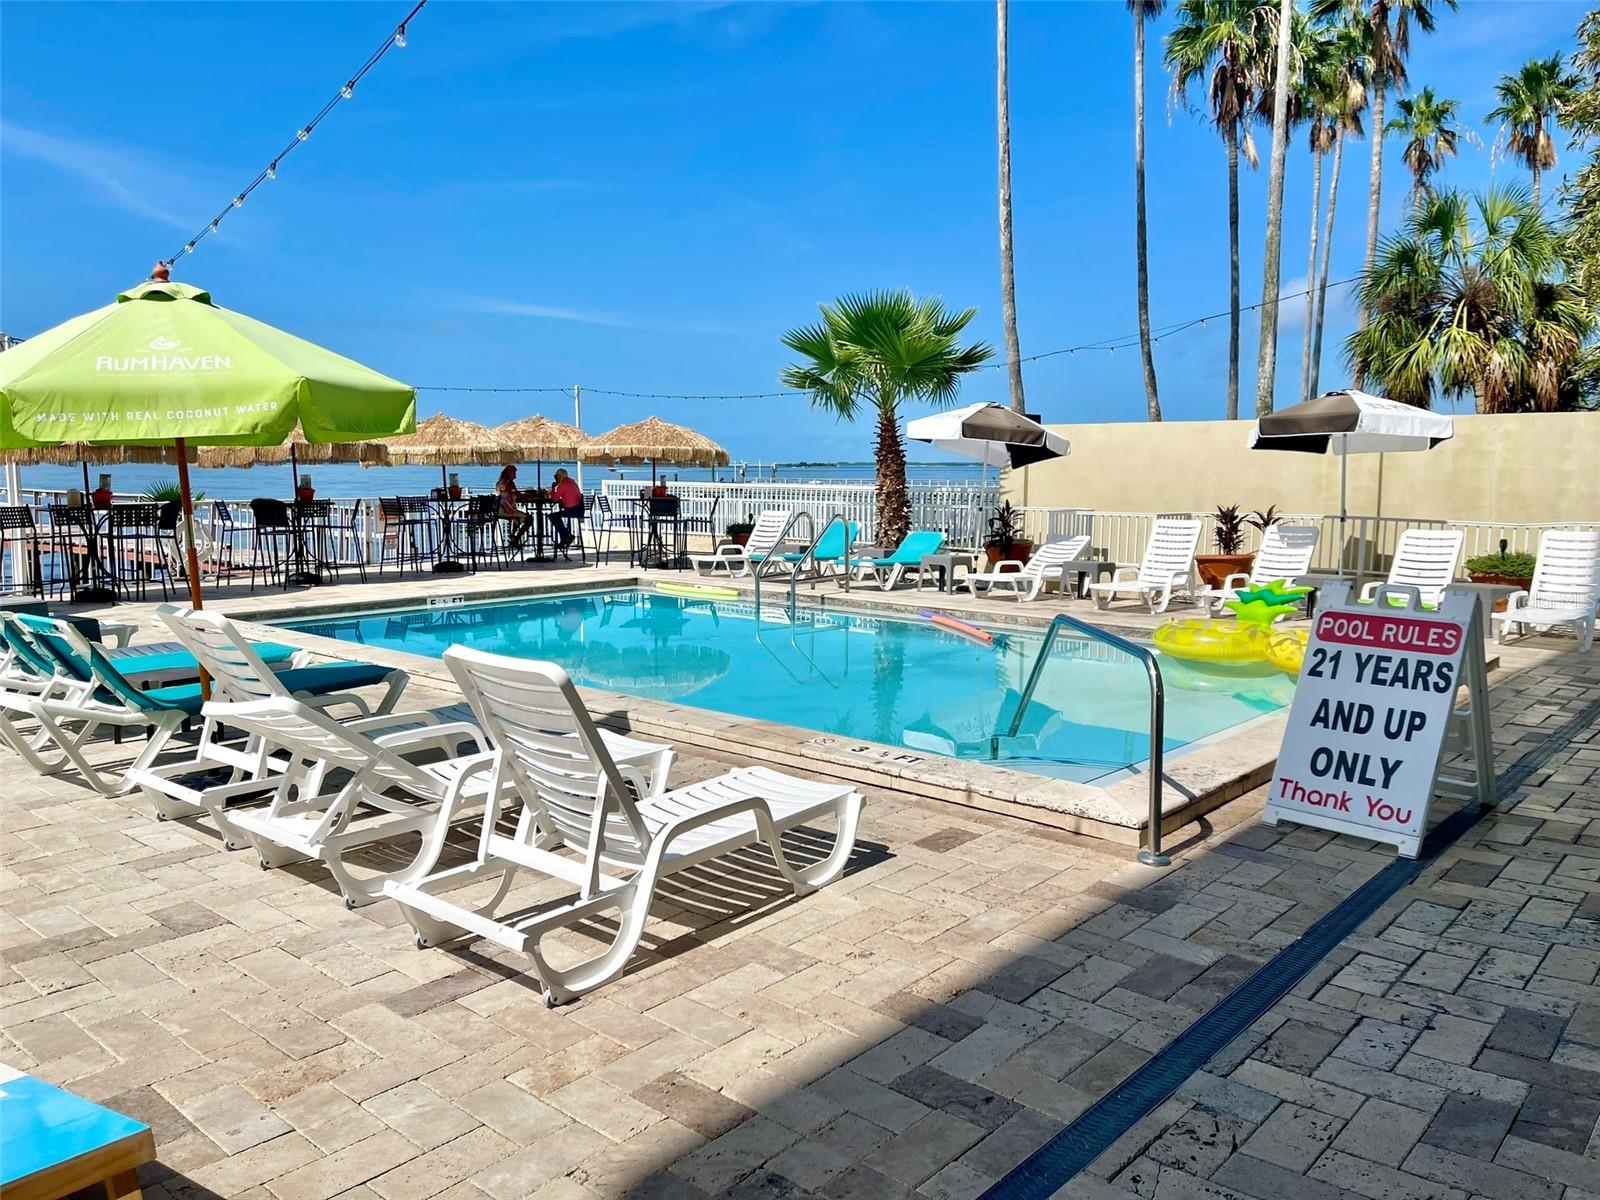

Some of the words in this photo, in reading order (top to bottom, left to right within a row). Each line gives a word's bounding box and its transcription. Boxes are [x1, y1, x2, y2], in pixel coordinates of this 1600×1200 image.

[95, 355, 232, 372] RUMHAVEN
[36, 412, 77, 424] MADE
[83, 411, 119, 422] WITH
[126, 410, 160, 421] REAL
[166, 406, 229, 420] COCONUT
[235, 401, 278, 415] WATER
[1318, 617, 1374, 640] POOL
[1381, 623, 1458, 649] RULES
[1307, 648, 1344, 680] 21
[1354, 652, 1455, 694] YEARS
[1309, 698, 1375, 735] AND
[1383, 707, 1427, 742] UP
[893, 754, 925, 763] FT
[1309, 747, 1404, 790] ONLY
[1279, 777, 1354, 813] Thank
[1365, 794, 1413, 825] You
